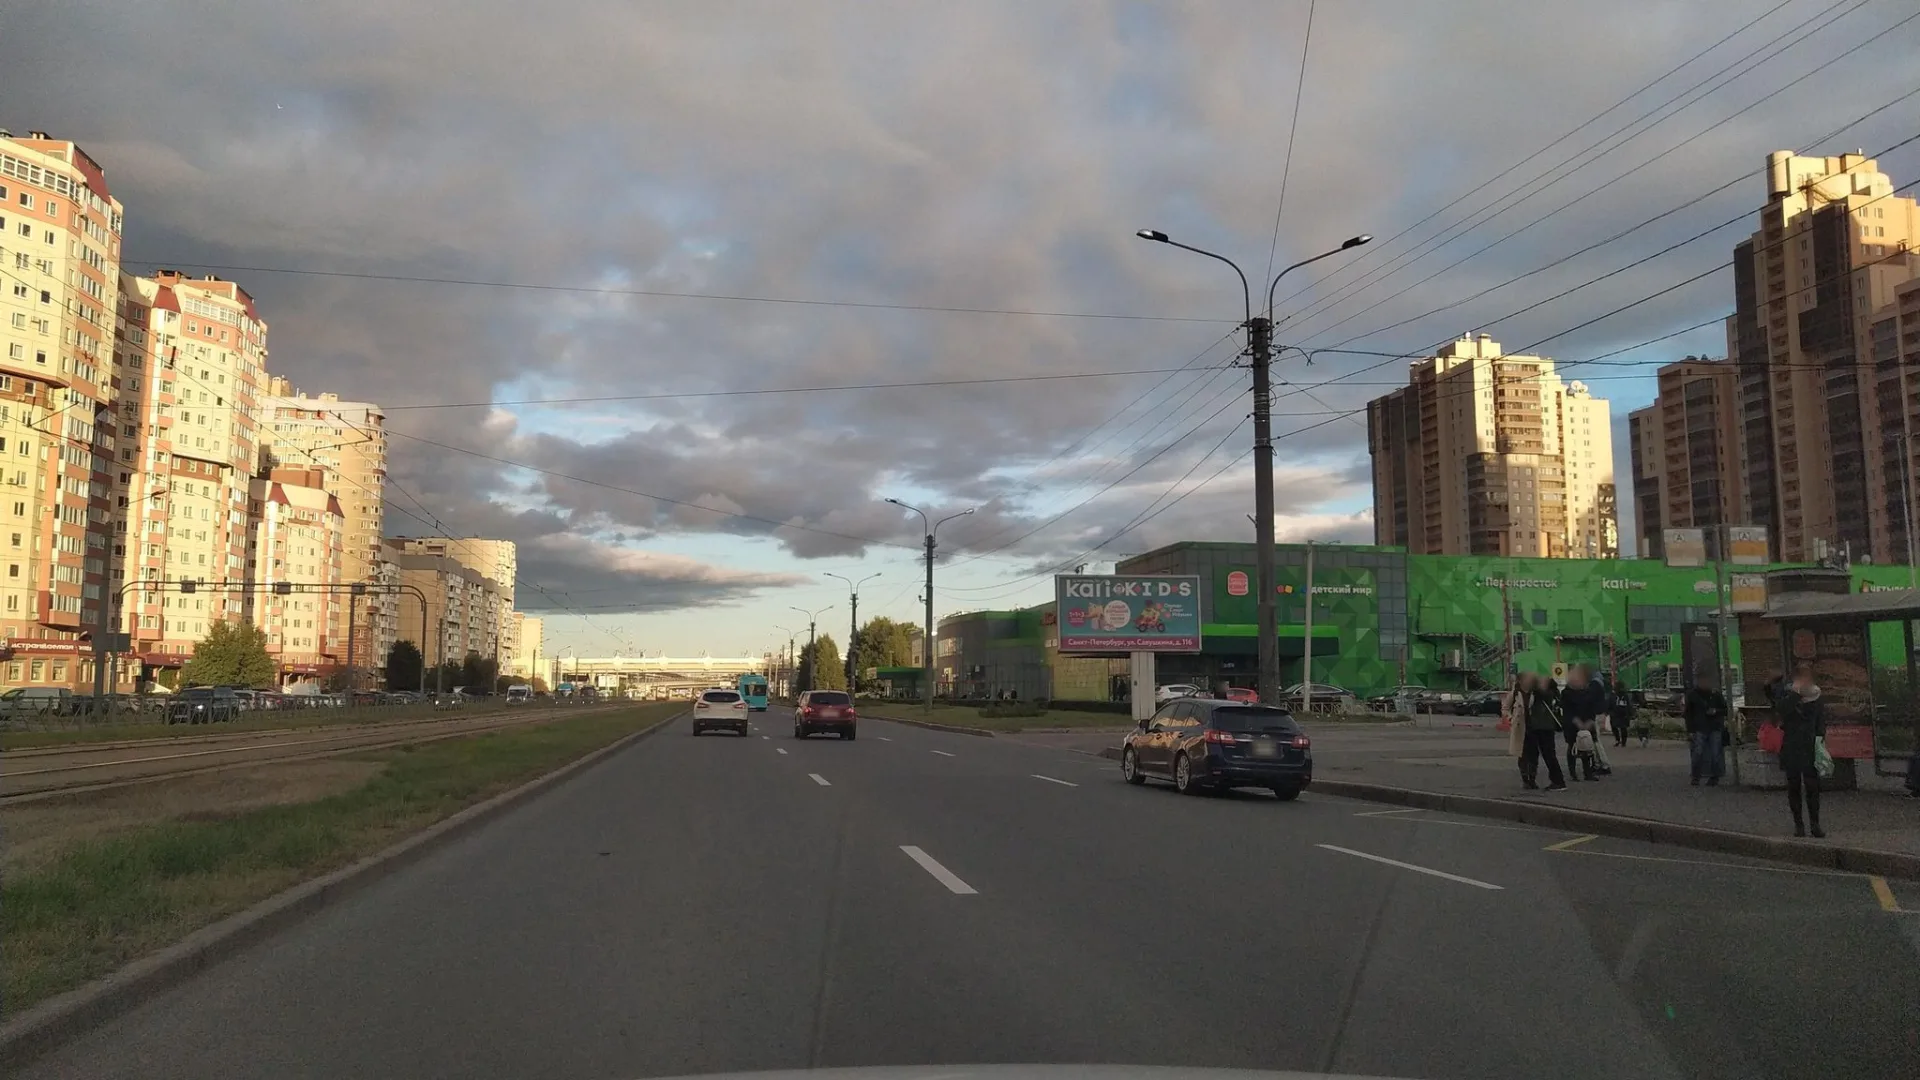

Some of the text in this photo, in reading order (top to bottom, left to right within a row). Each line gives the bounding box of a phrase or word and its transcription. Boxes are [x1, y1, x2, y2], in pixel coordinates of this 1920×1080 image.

[1066, 579, 1192, 598] kari KIDS
[1602, 577, 1629, 589] kari
[1311, 584, 1372, 597] детский мир
